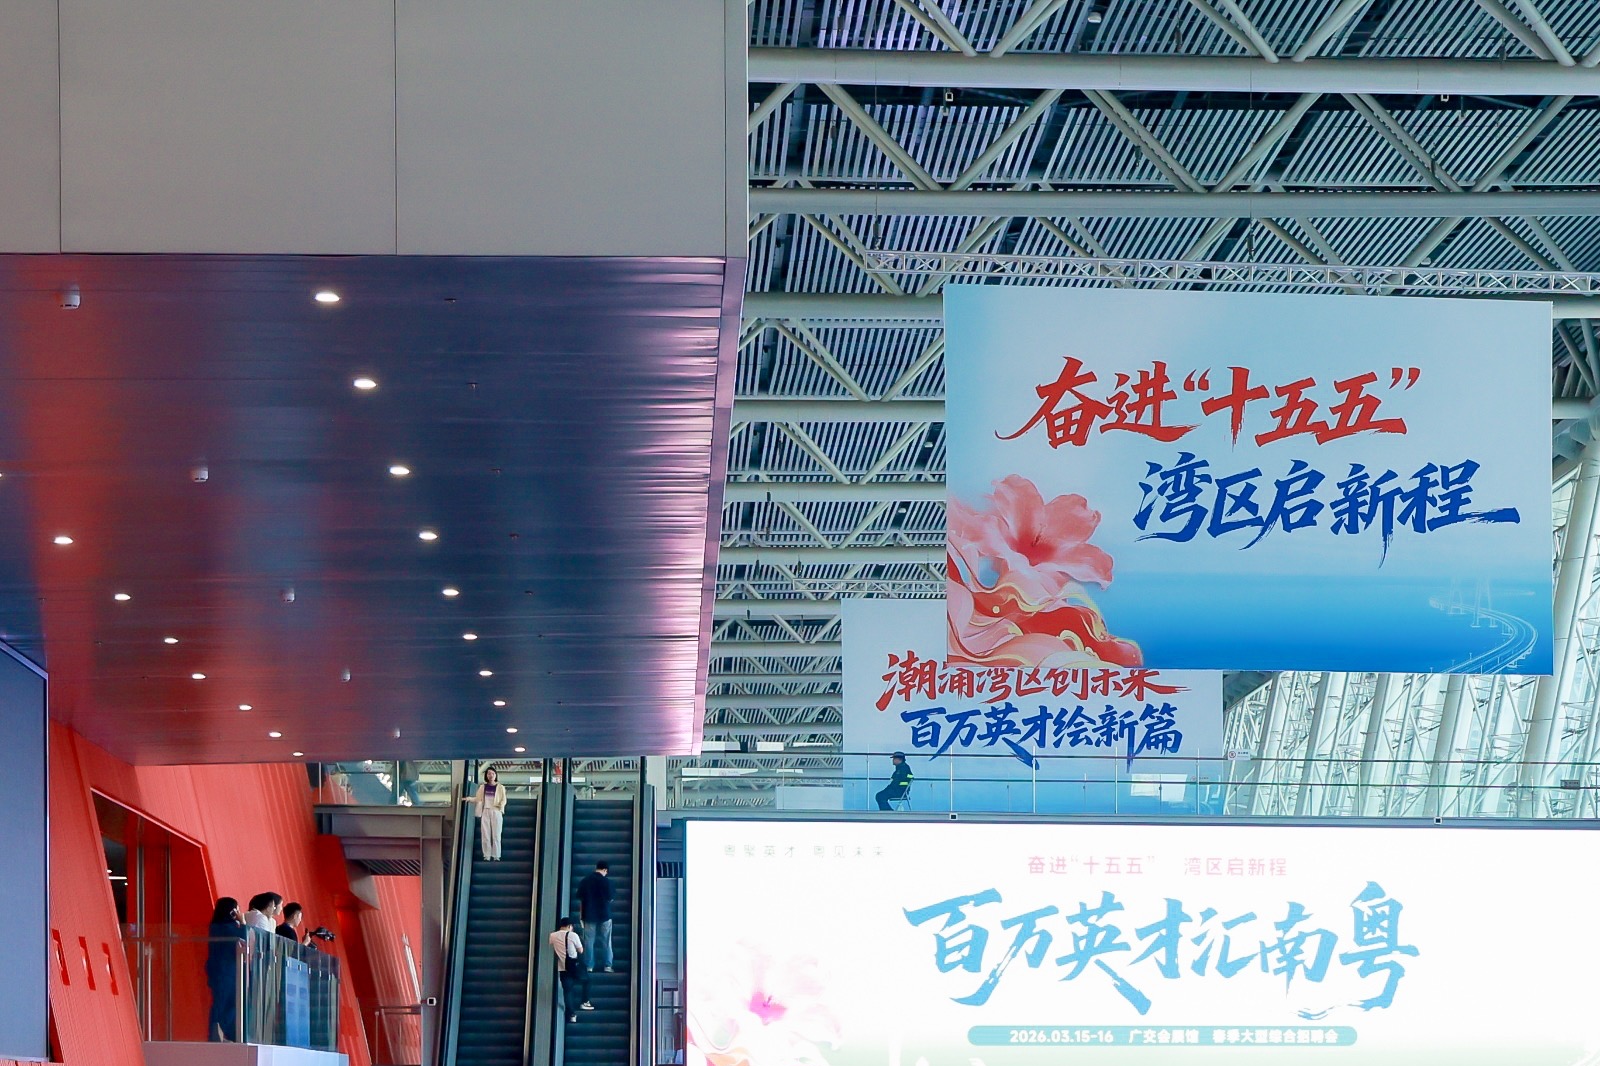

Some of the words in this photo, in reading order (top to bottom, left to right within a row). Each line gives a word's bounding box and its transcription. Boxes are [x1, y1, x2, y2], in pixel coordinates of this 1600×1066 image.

[995, 356, 1421, 448] 奋进“十五五”
[1133, 451, 1521, 568] 湾区启新程
[900, 702, 1182, 774] 百万英才绘新篇
[1184, 856, 1288, 877] 湾区启新程
[902, 880, 1420, 1021] 百万英才汇南粤
[1009, 1028, 1114, 1044] 2026.03.15-16
[1128, 1028, 1200, 1044] 广交会展馆
